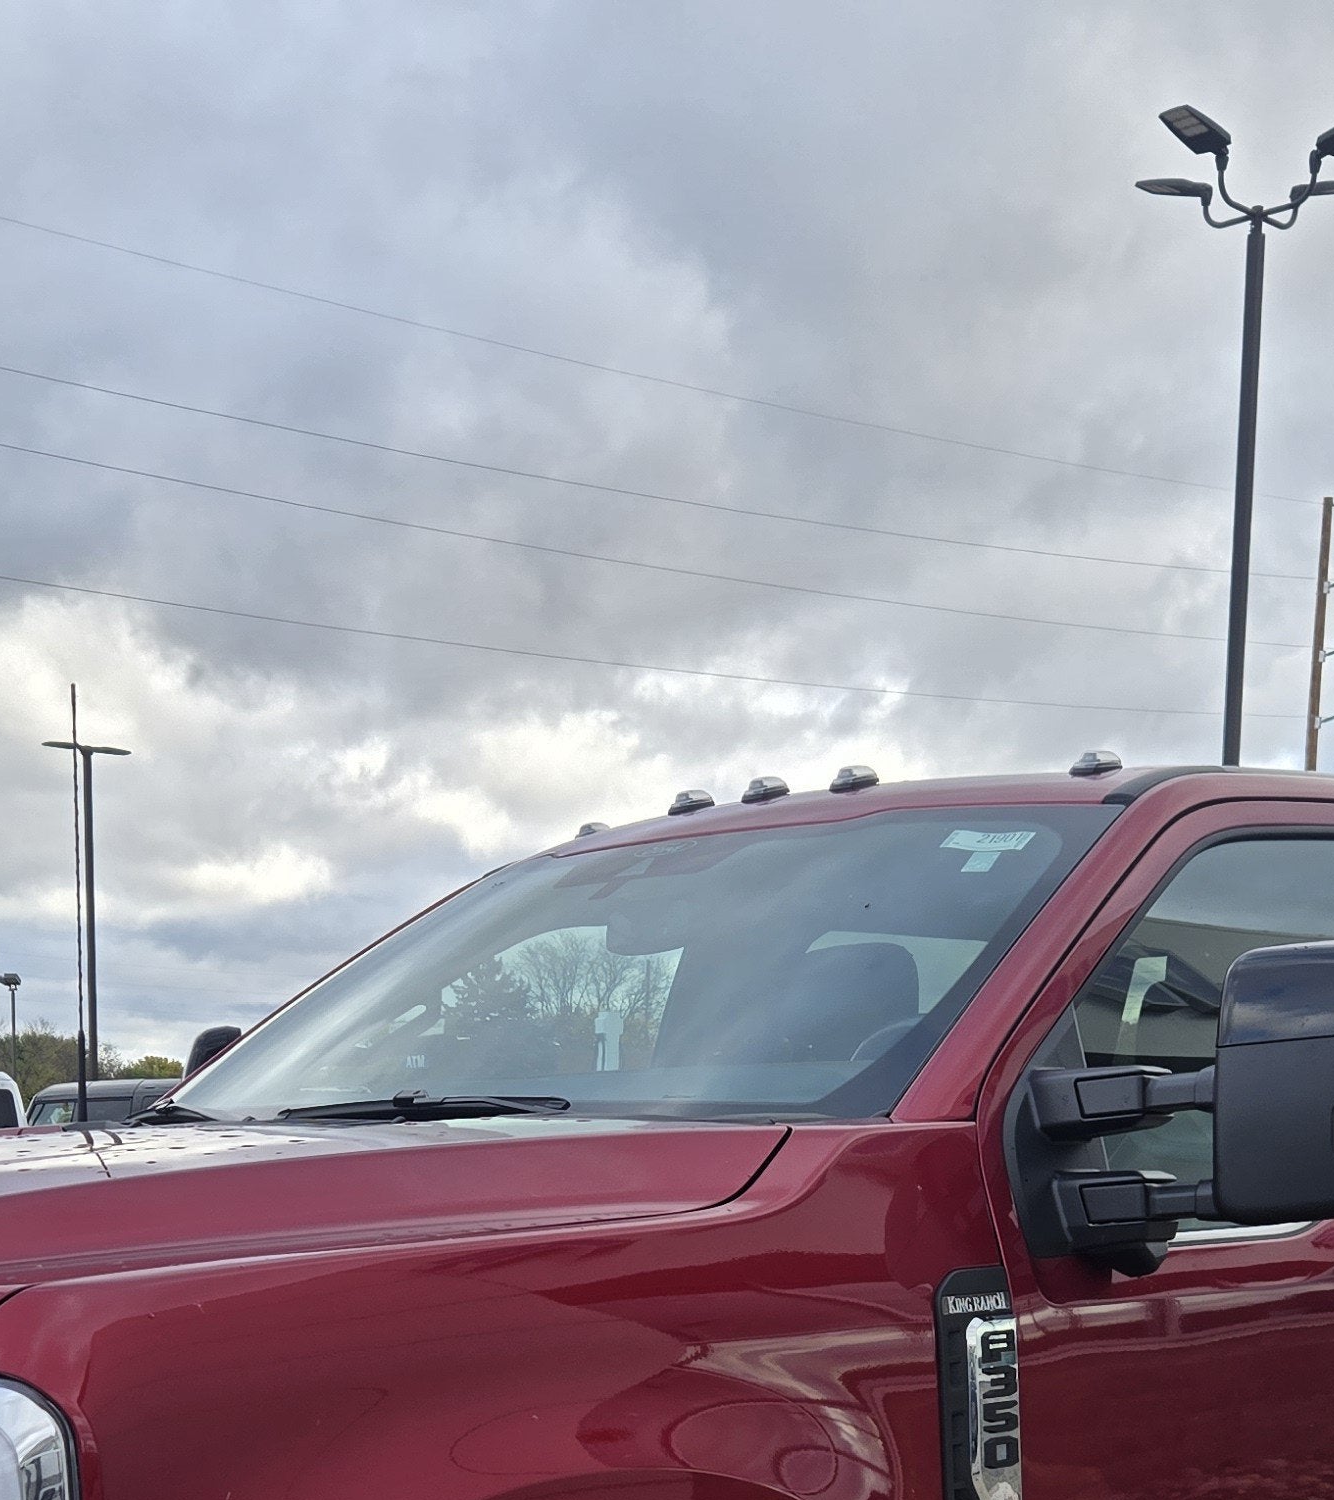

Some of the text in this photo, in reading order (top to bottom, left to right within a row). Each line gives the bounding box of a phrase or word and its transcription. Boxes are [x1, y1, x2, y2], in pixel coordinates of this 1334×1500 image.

[406, 1055, 424, 1068] ATM
[947, 1292, 1007, 1314] KING RANCH
